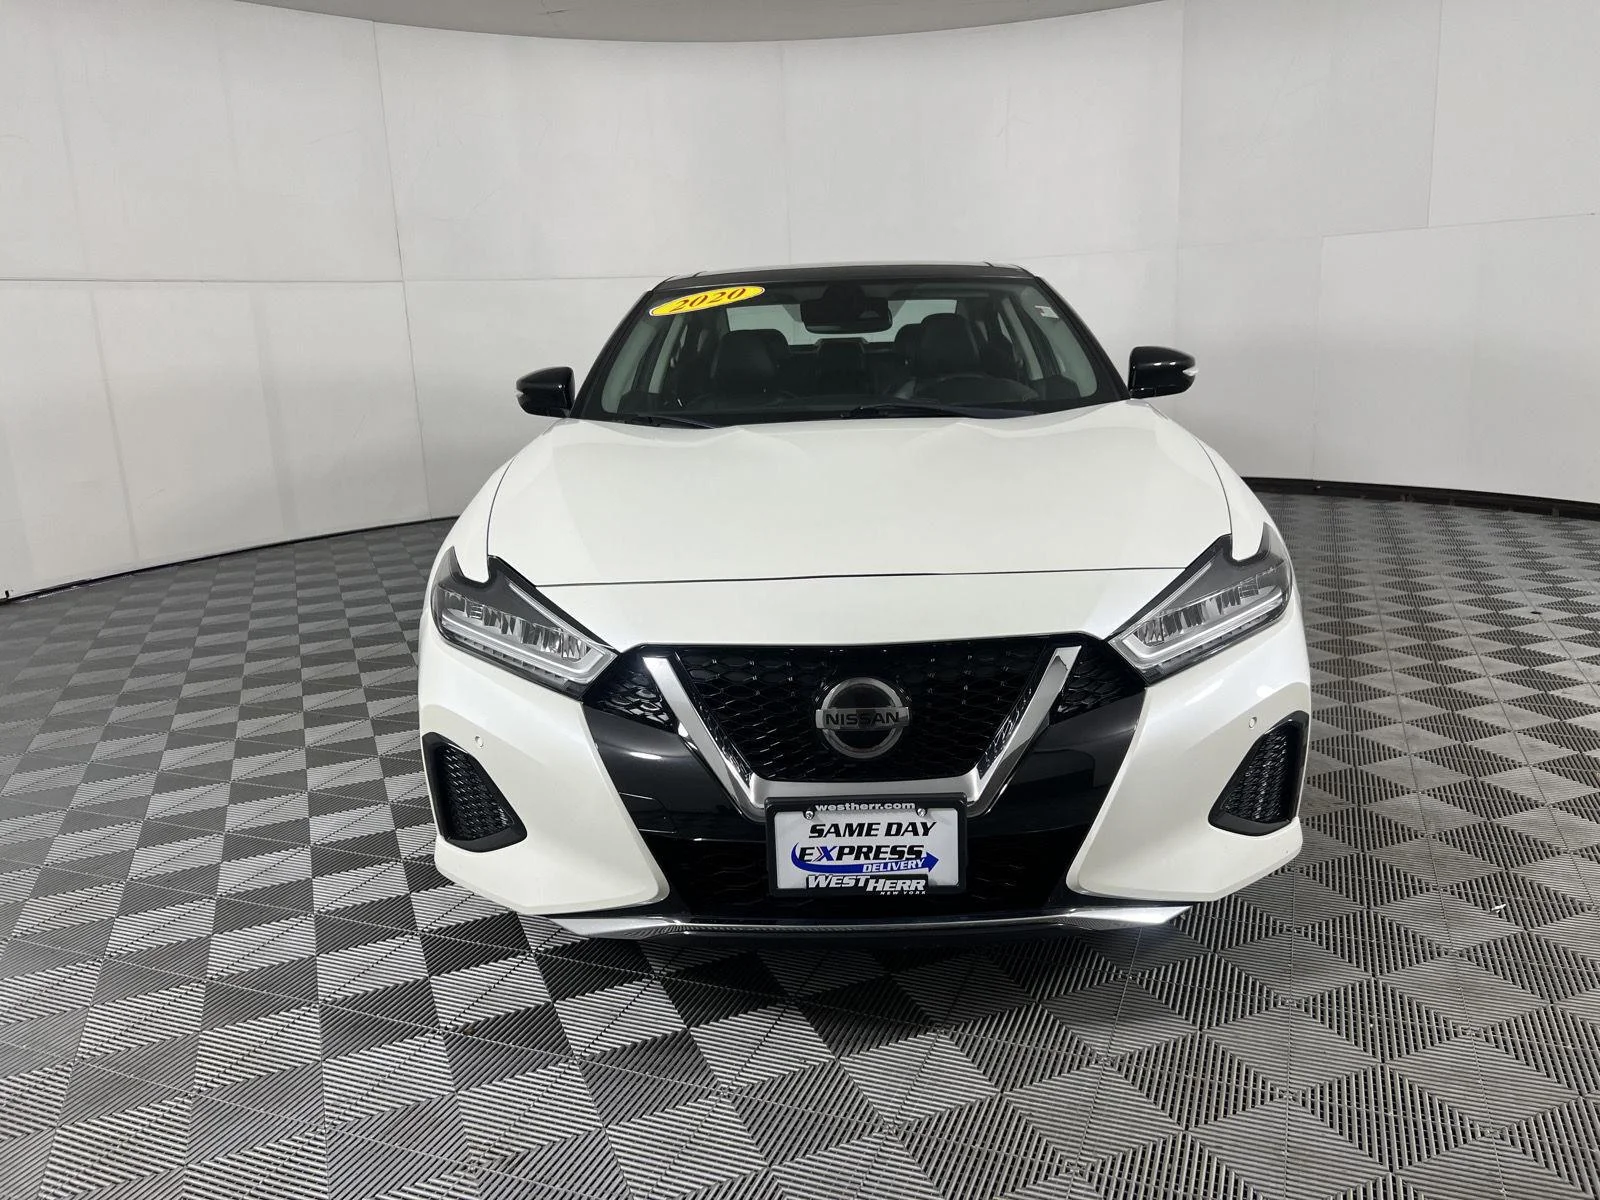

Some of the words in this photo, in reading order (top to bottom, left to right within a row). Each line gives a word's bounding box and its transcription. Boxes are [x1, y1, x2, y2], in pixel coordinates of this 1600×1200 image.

[669, 288, 746, 312] 2020
[825, 711, 899, 725] NISSAN
[815, 803, 915, 812] westherr.com
[809, 822, 880, 838] SAME
[885, 821, 937, 837] DAY
[799, 845, 924, 861] EXPRESS
[862, 858, 925, 872] DELIVERY
